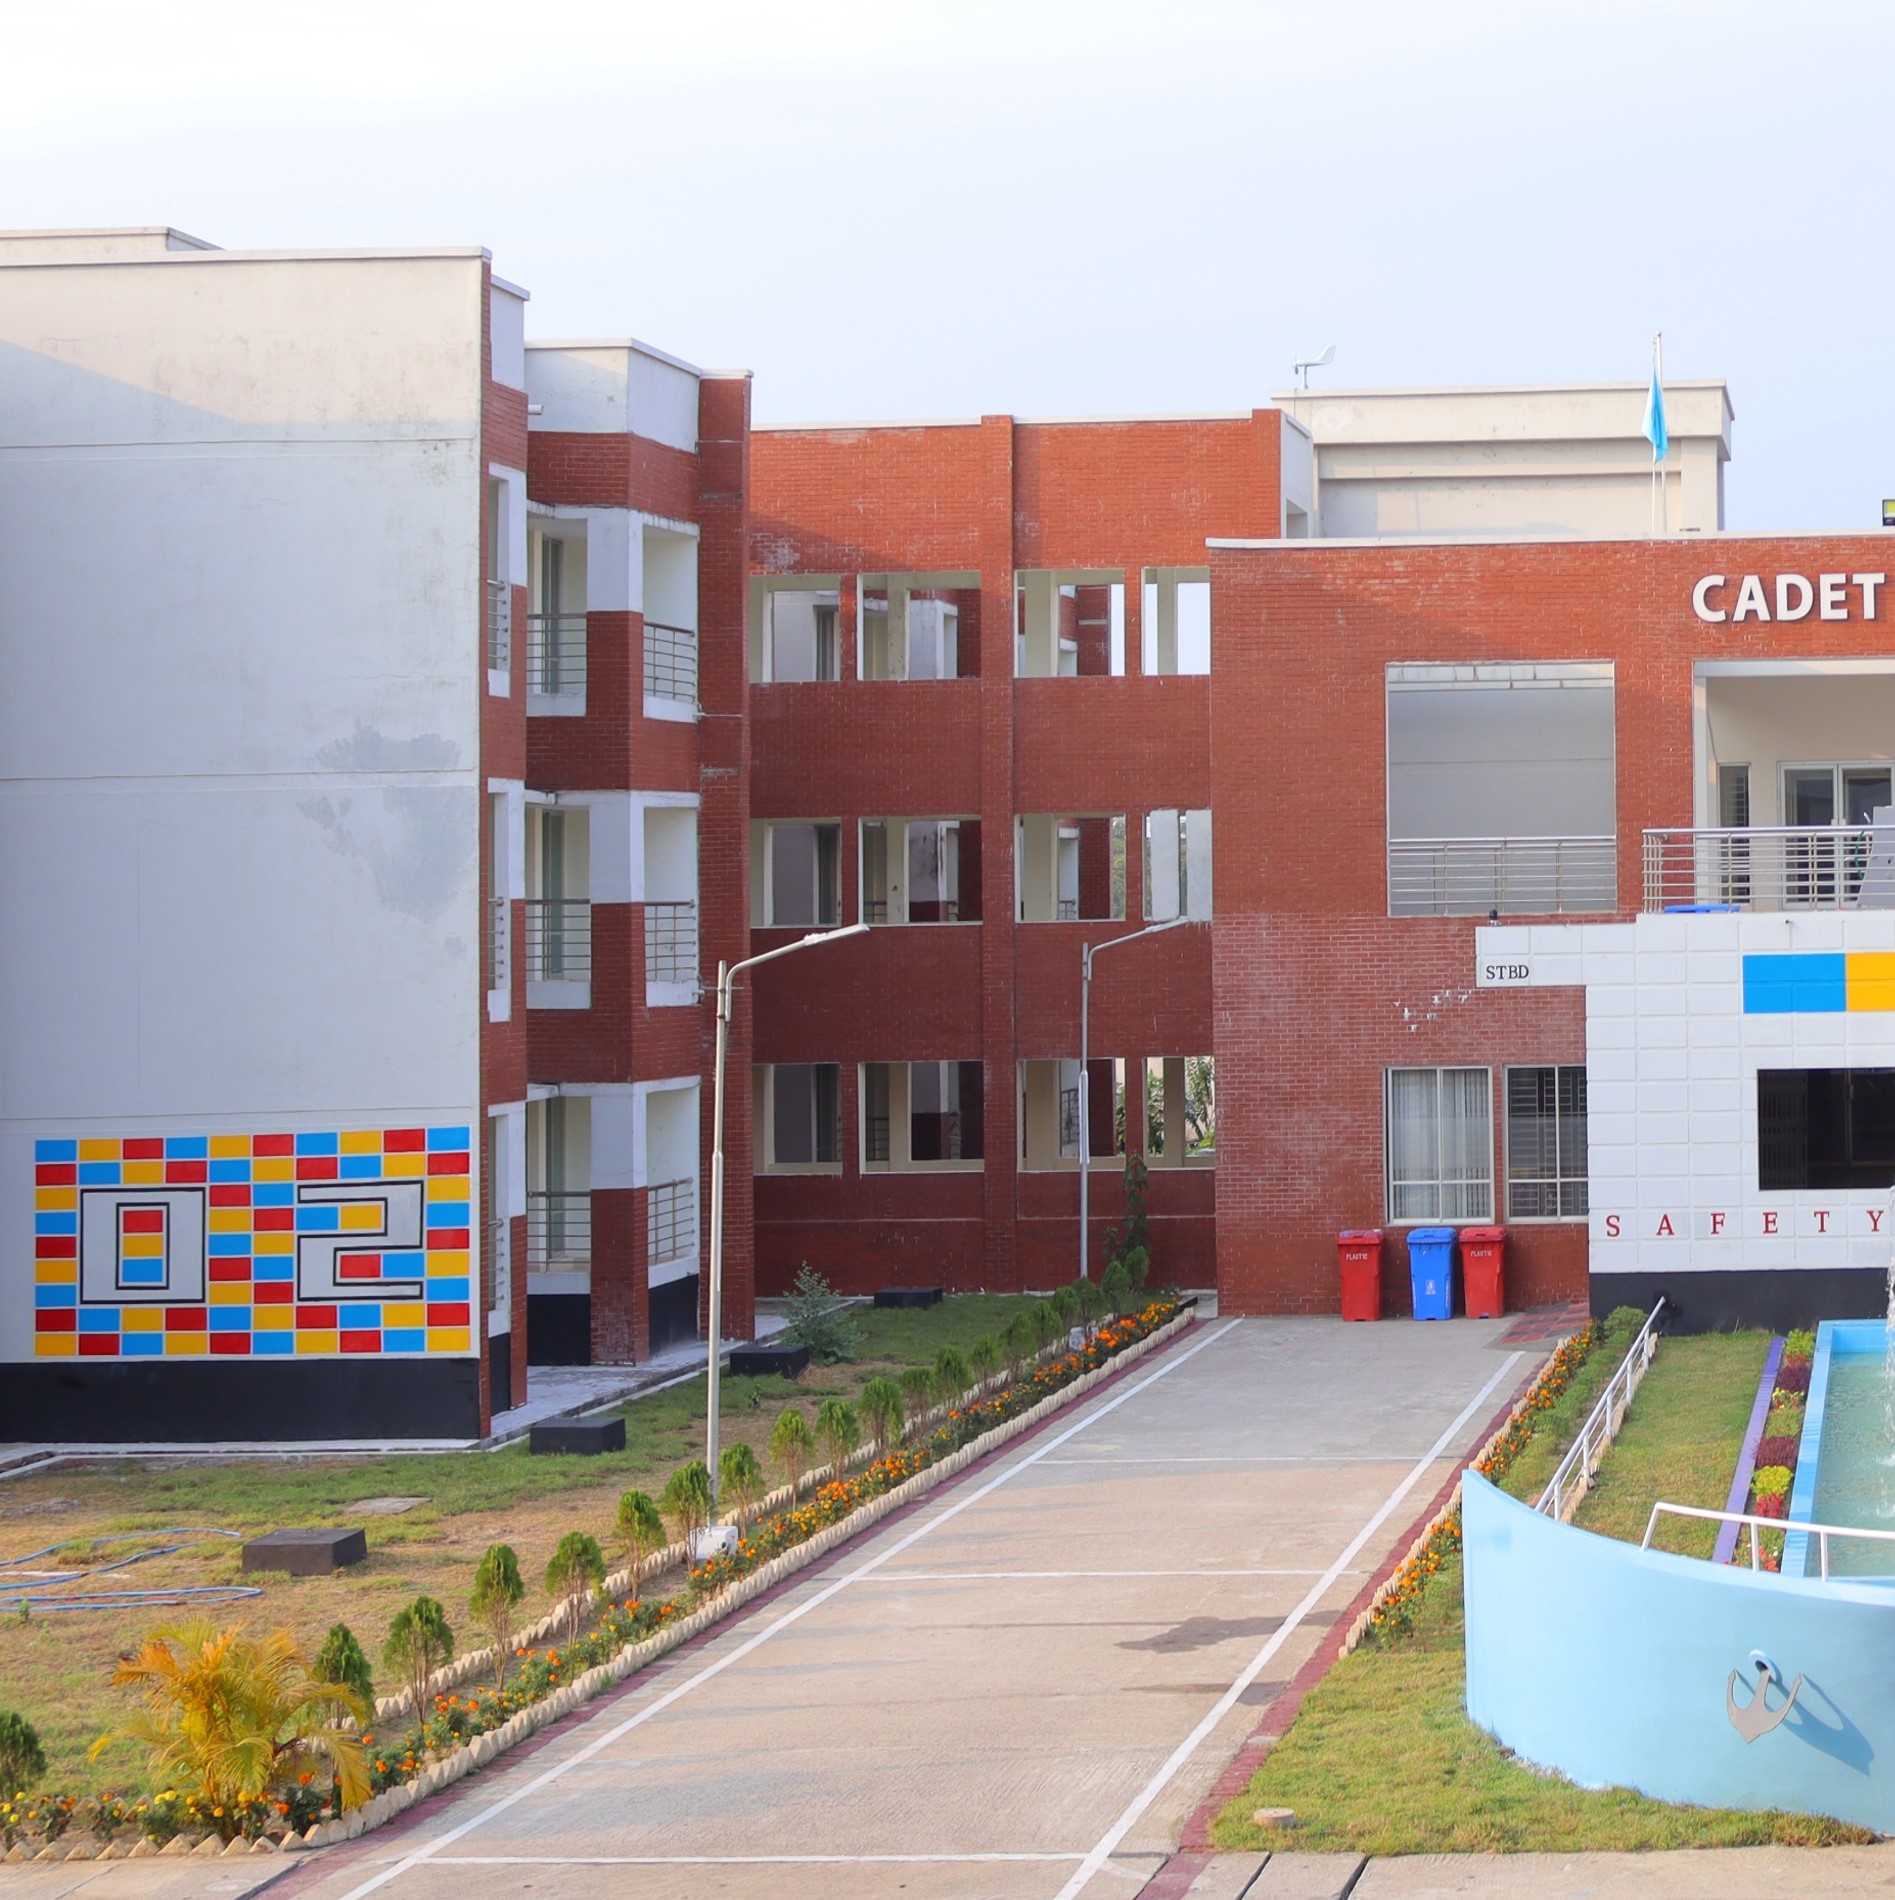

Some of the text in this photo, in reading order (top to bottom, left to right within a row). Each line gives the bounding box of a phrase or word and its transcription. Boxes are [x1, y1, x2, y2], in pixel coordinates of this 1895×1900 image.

[1692, 573, 1885, 622] CADET
[1486, 965, 1529, 979] STBD
[1606, 1210, 1884, 1237] SAFETY
